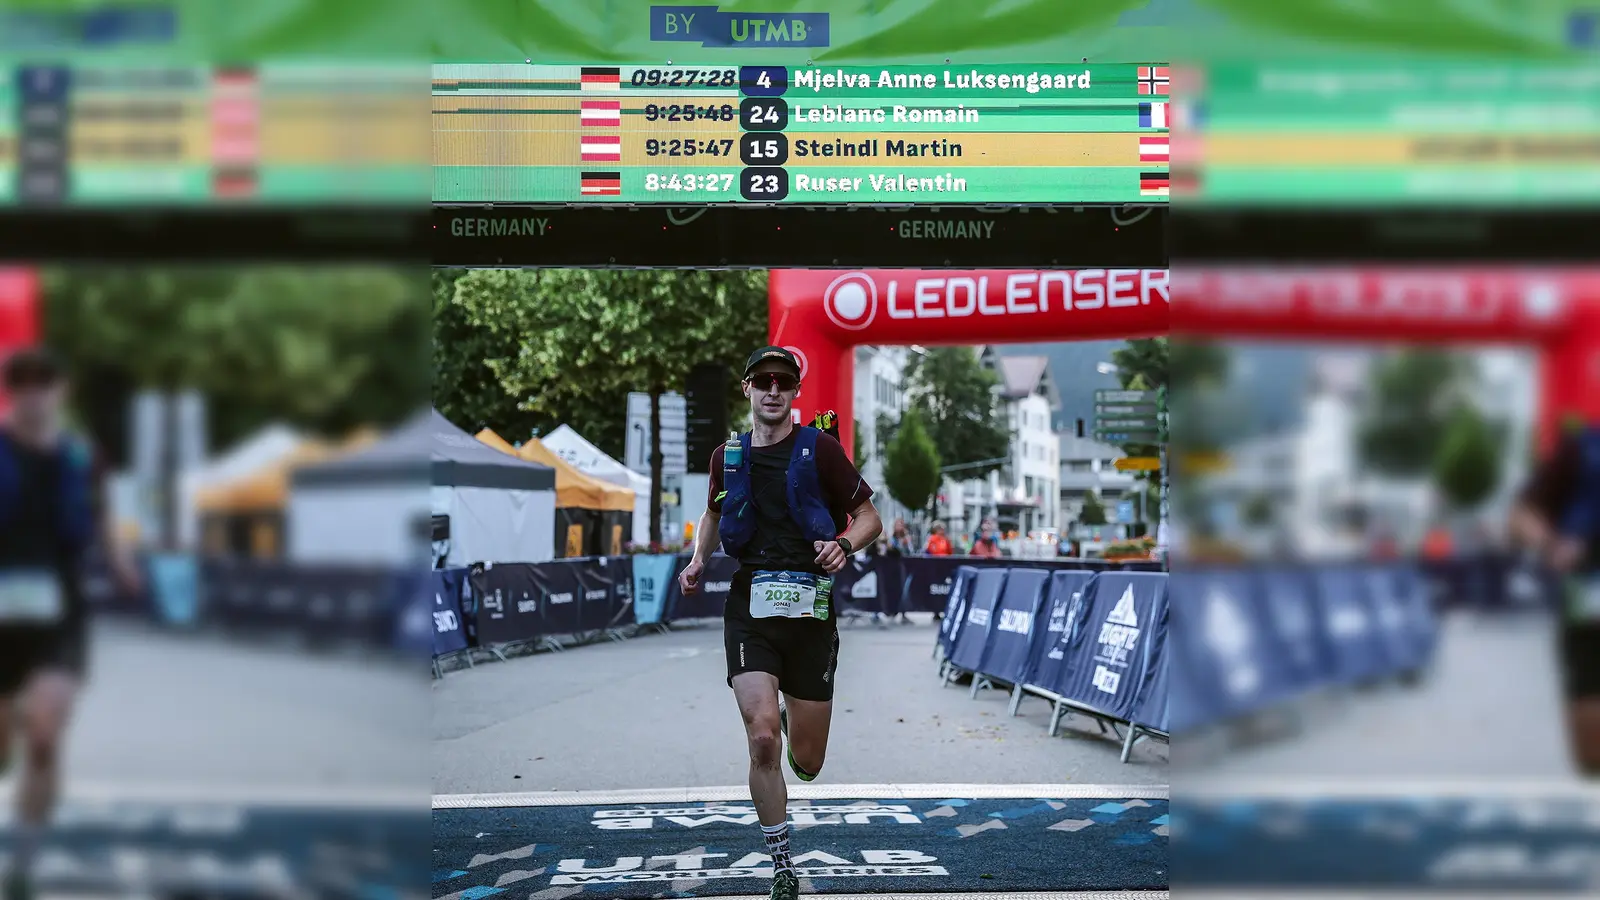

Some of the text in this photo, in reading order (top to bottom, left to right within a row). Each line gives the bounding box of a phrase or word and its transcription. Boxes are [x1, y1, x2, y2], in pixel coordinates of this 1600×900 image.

[665, 13, 808, 42] BY UTMB
[631, 69, 1091, 94] 09:27:28 4 Mjelva Anne Luksengaard
[645, 104, 980, 124] 9:25:48 24 Leblanc Romain
[645, 139, 963, 158] 9:25:47 15 Steindl Martin
[645, 173, 967, 193] 8:43:27 23 Ruser Valentin
[450, 218, 550, 237] GERMANY
[899, 220, 996, 239] GERMANY
[887, 268, 1169, 319] LEDLENSER
[765, 589, 801, 603] 2023
[557, 850, 938, 873] UTMB
[569, 869, 755, 882] WORLD
